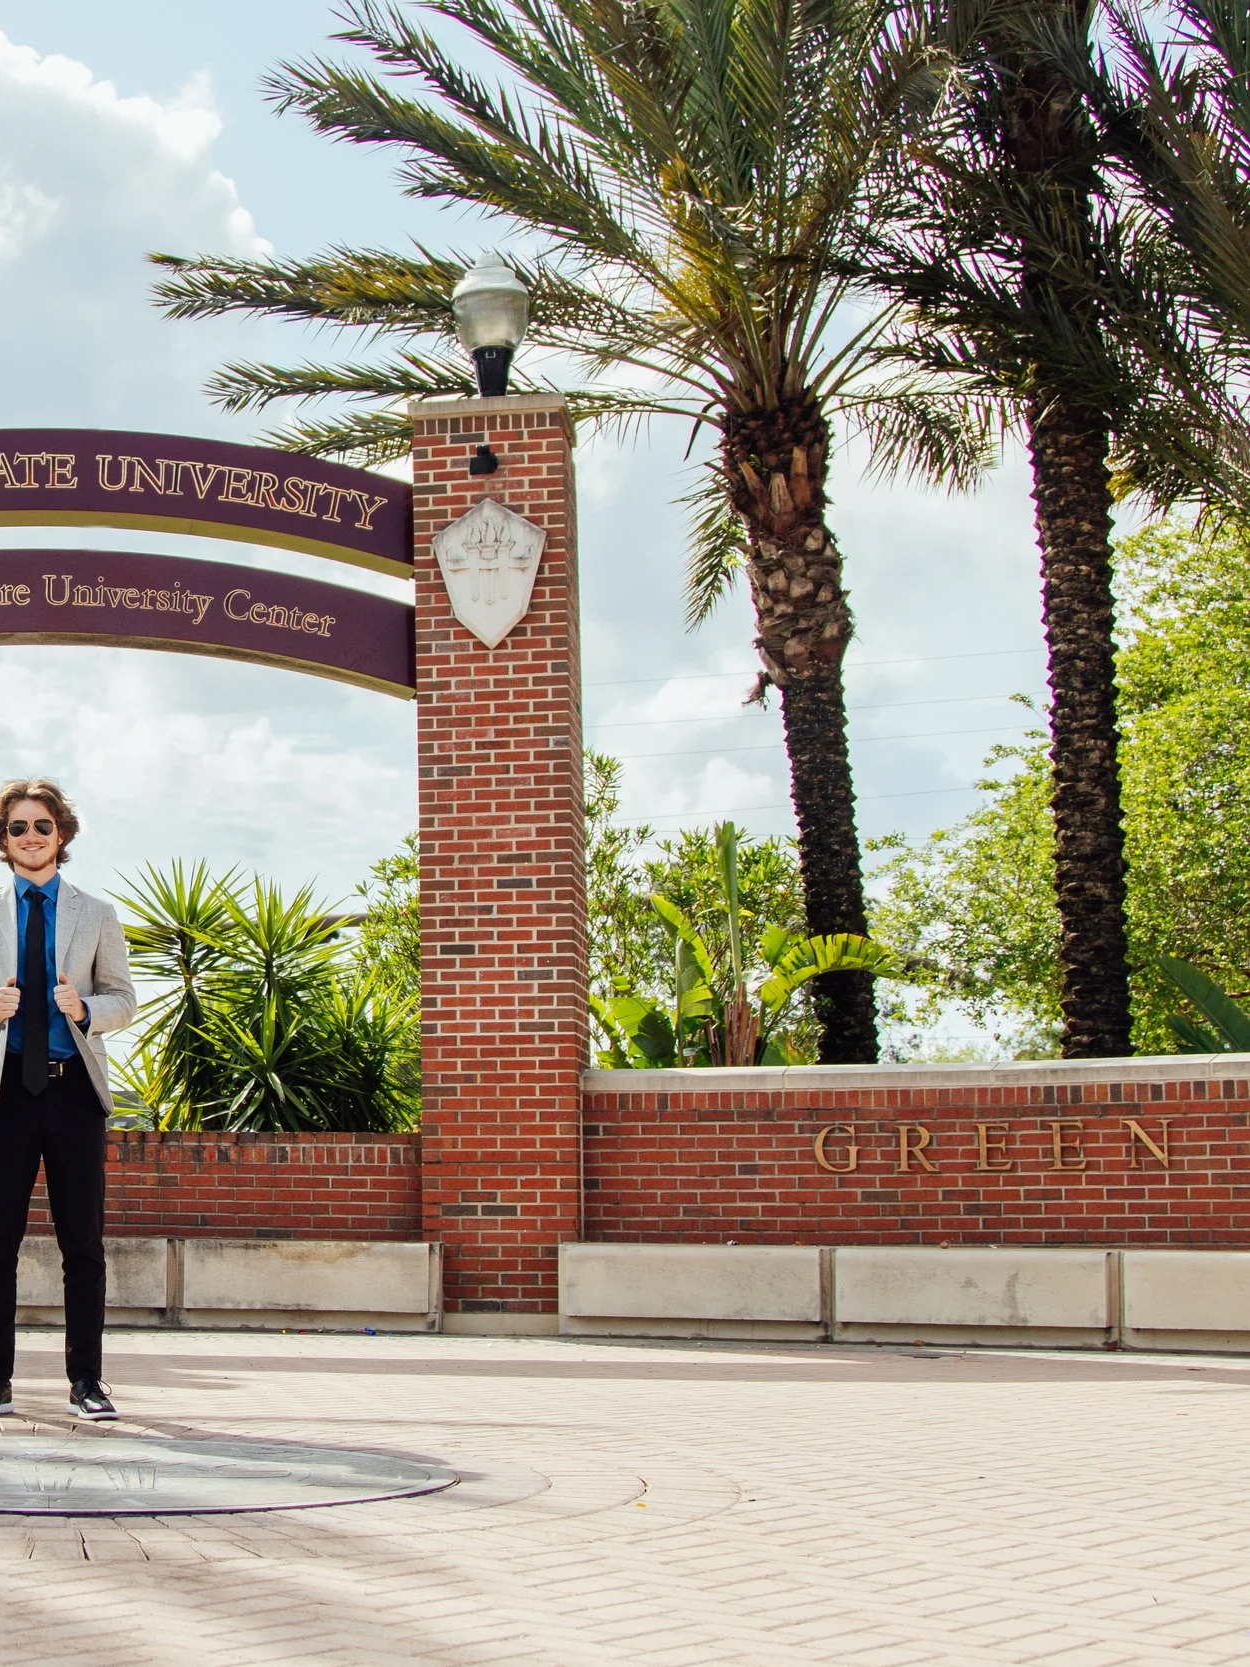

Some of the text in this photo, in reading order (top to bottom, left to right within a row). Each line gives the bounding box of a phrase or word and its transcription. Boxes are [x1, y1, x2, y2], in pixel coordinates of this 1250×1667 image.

[96, 454, 387, 530] UNIVERSITY
[42, 574, 214, 625] University
[223, 589, 336, 637] Center
[813, 1119, 1174, 1174] GREEN
